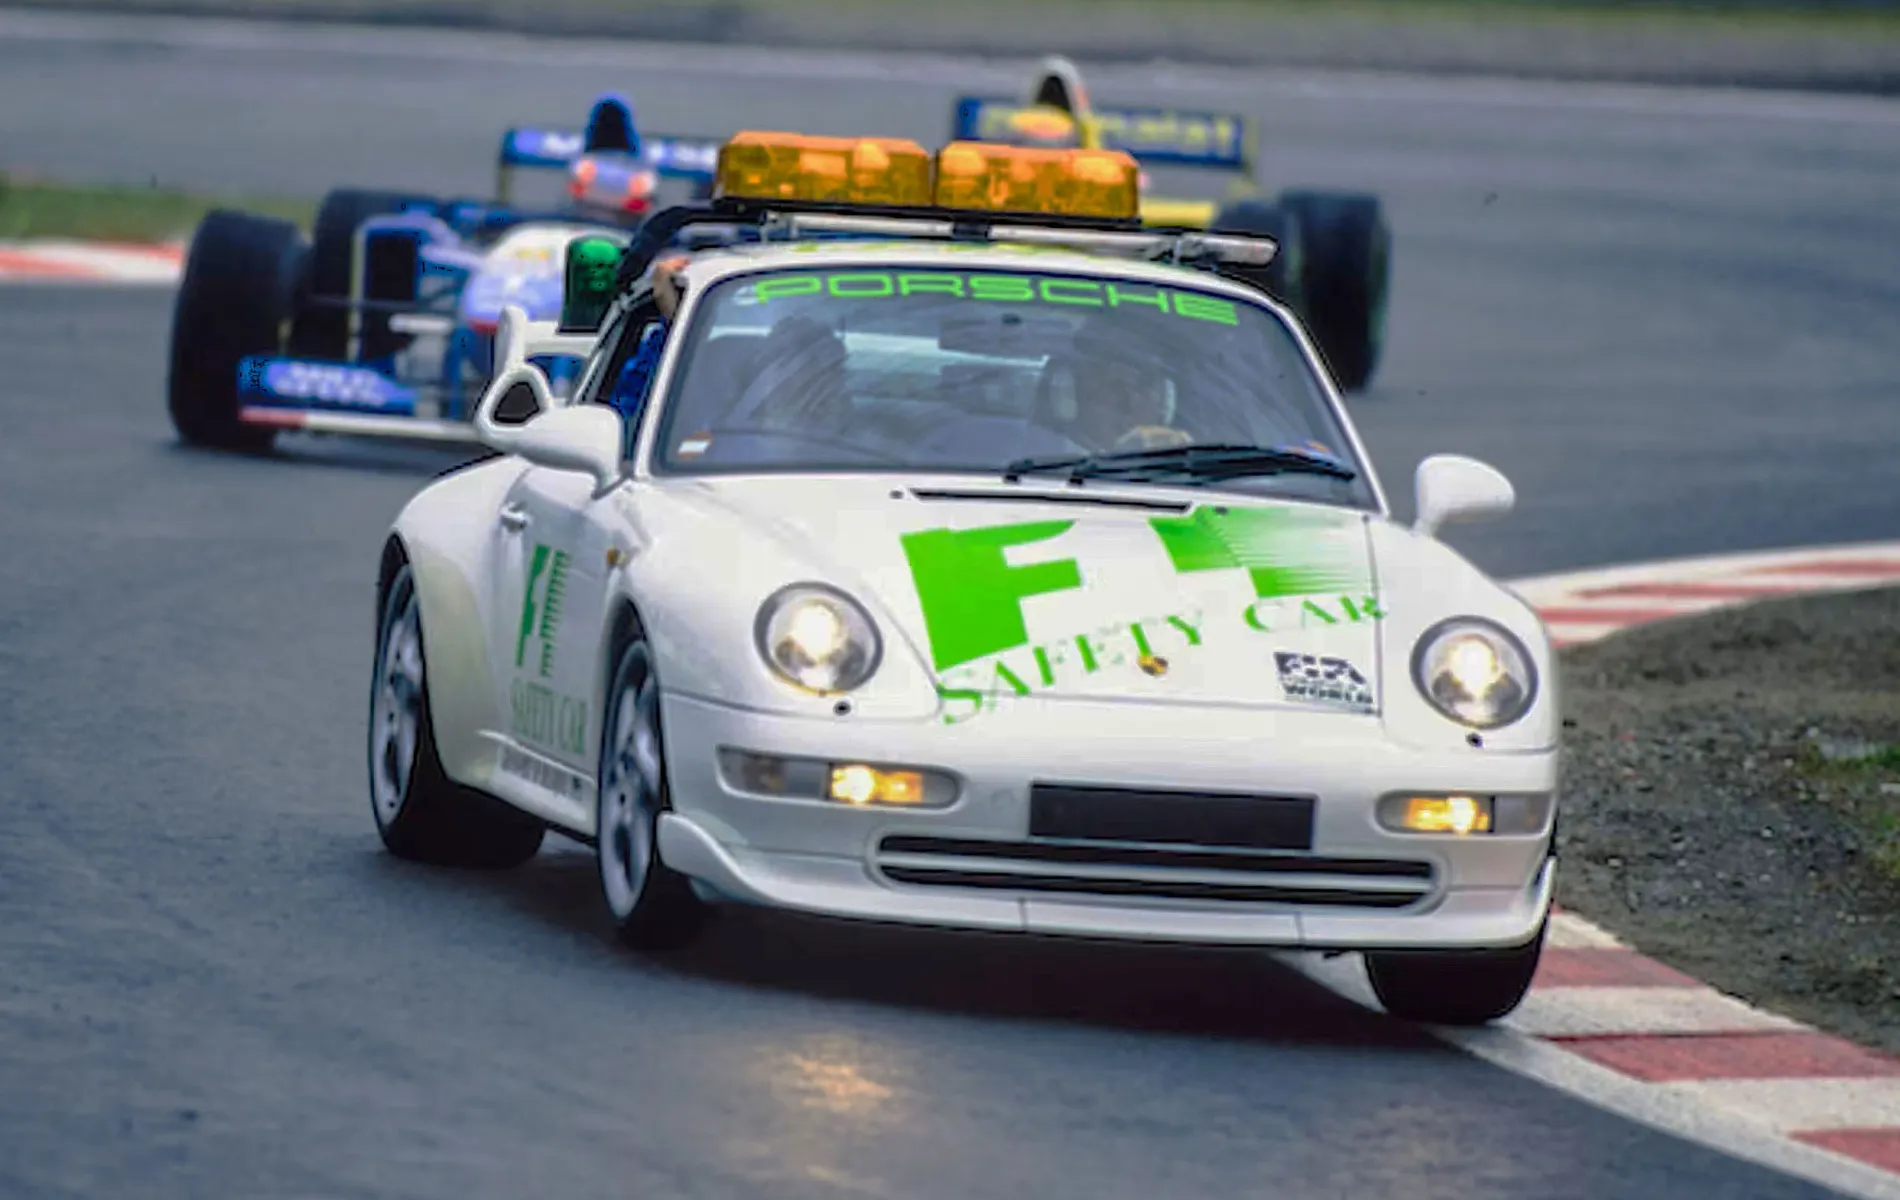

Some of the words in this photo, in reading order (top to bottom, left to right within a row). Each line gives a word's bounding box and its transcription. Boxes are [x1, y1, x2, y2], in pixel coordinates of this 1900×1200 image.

[754, 272, 1240, 327] PORSCHE
[935, 609, 1204, 726] SAFETY
[1242, 595, 1388, 634] CAR
